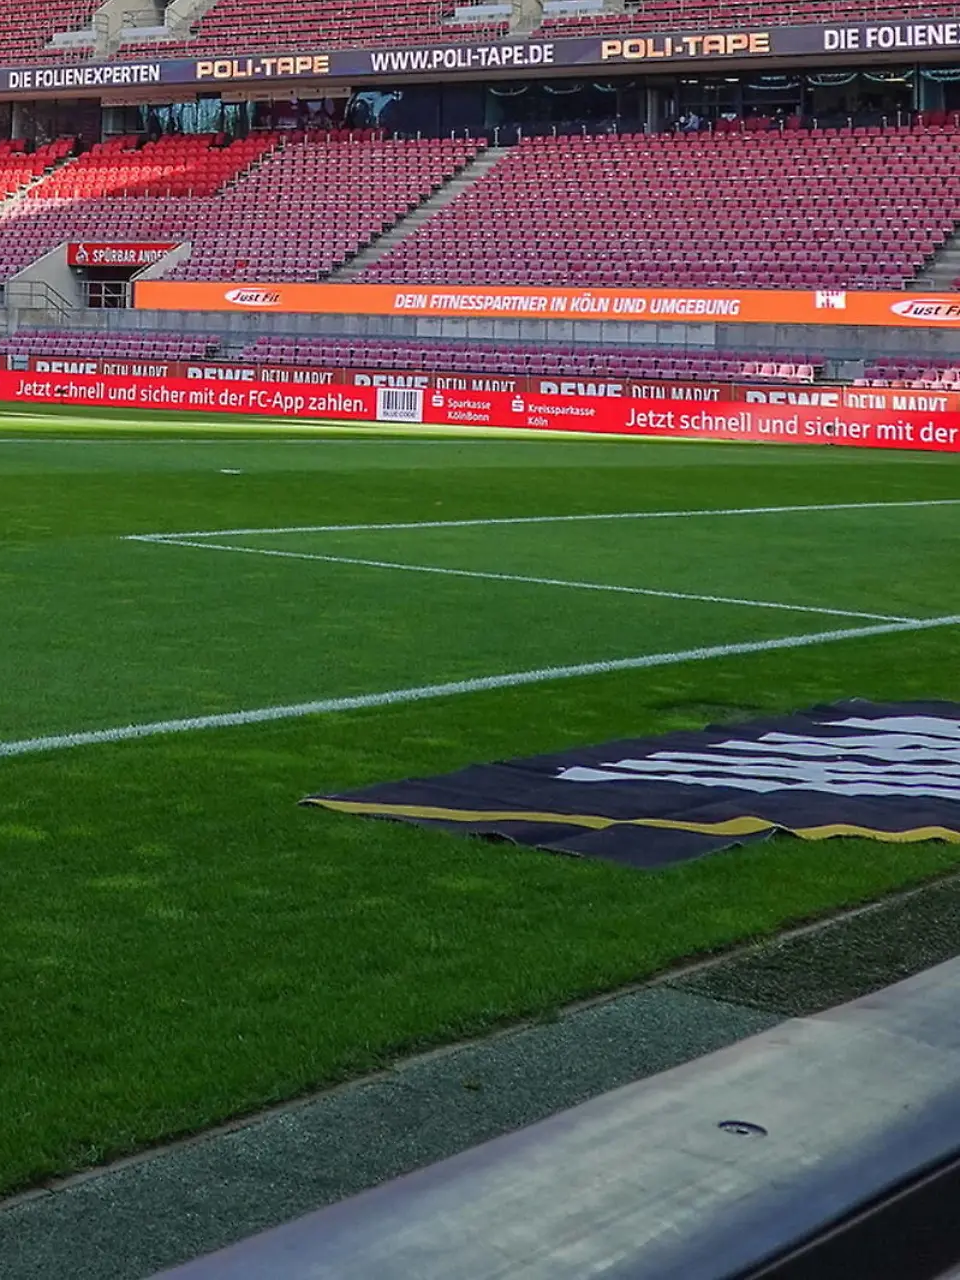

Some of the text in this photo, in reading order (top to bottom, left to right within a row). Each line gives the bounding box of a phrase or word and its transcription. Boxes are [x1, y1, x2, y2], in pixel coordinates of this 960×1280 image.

[601, 33, 770, 60] POLI-TAPE
[824, 23, 960, 50] DIE FOLIENE
[196, 55, 329, 79] POLI-TAPE
[371, 44, 554, 71] WWW.POLI-TAPE.DE
[9, 65, 160, 88] DIE FOLIENEXPERTEN
[233, 291, 280, 303] Just Fit
[394, 292, 741, 316] DEIN FITNESSPARTNER IN KÖLN UND UMGEBUNG
[902, 303, 942, 316] Just
[16, 380, 367, 413] Jetzt schnell und sicher mit der FC-App zahlen.
[448, 398, 490, 411] Sparkasse
[447, 411, 489, 422] KölnBonn
[527, 416, 548, 427] Köln
[528, 404, 595, 417] Kreissparkasse
[625, 407, 958, 444] Jetzt schnell und sicher mit der
